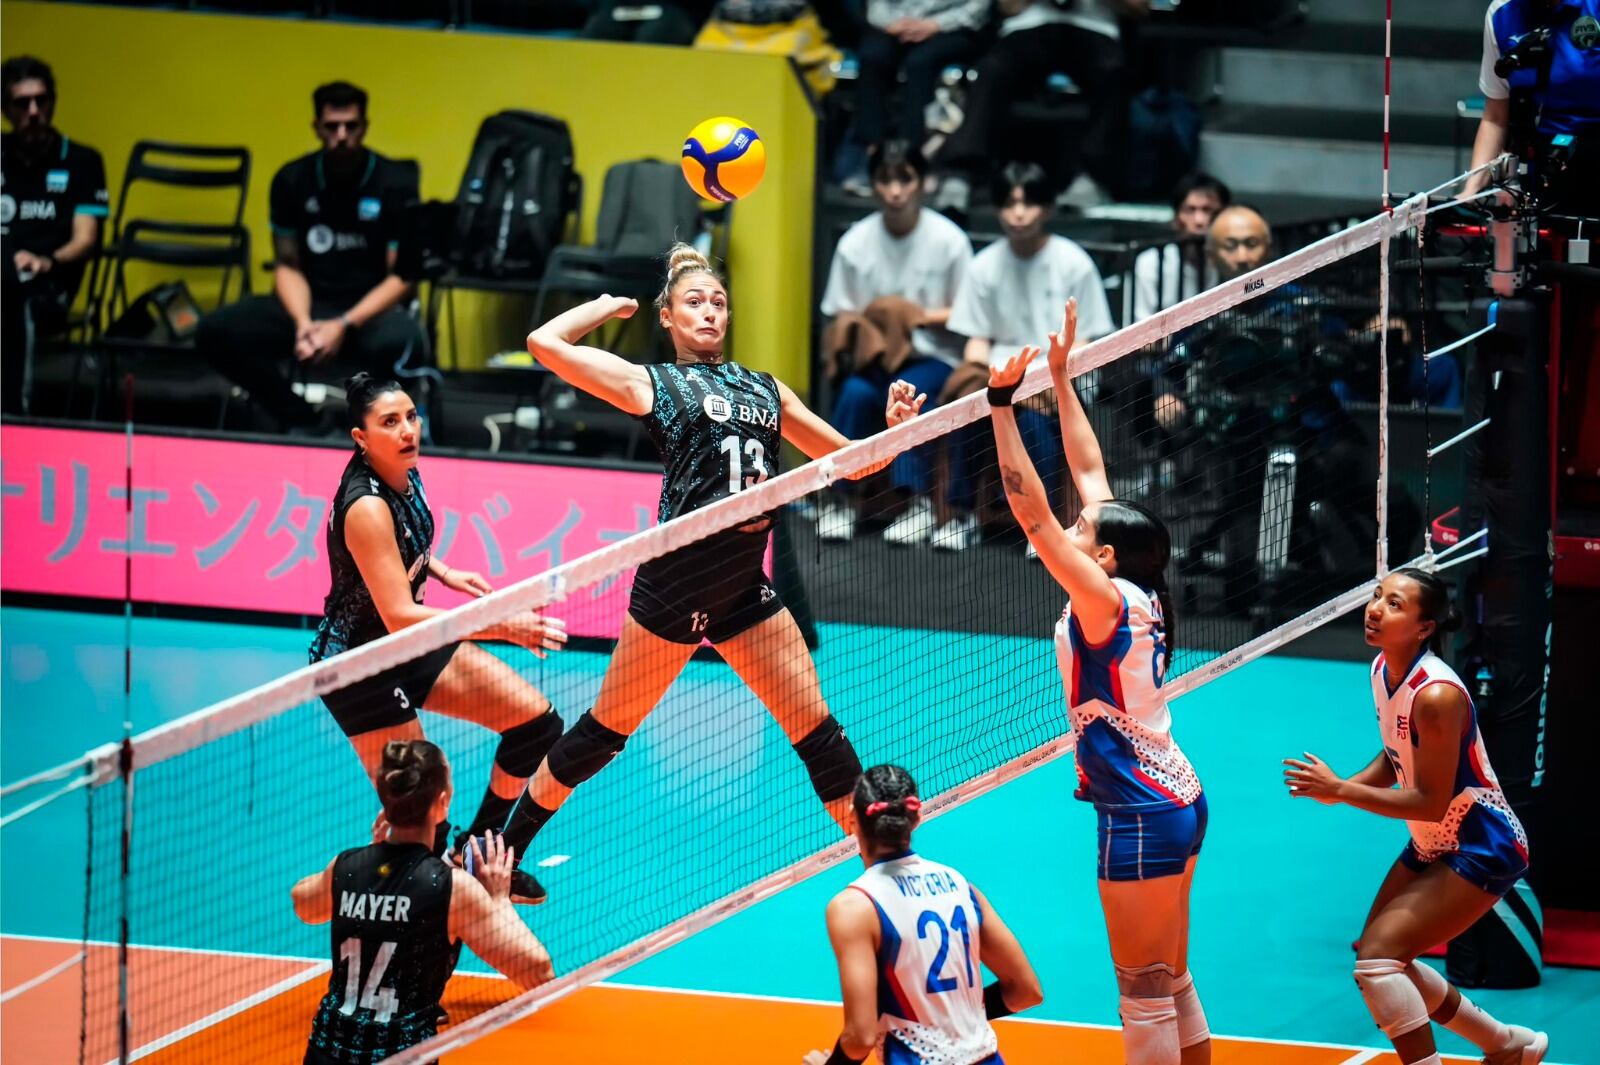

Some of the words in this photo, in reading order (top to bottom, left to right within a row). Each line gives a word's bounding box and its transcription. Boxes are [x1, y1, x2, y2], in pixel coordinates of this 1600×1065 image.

[738, 404, 779, 432] BNA
[720, 435, 769, 494] 13
[691, 611, 709, 632] 13
[393, 687, 410, 709] 3
[339, 890, 411, 923] MAYER
[917, 904, 974, 994] 21
[338, 936, 400, 1024] 14
